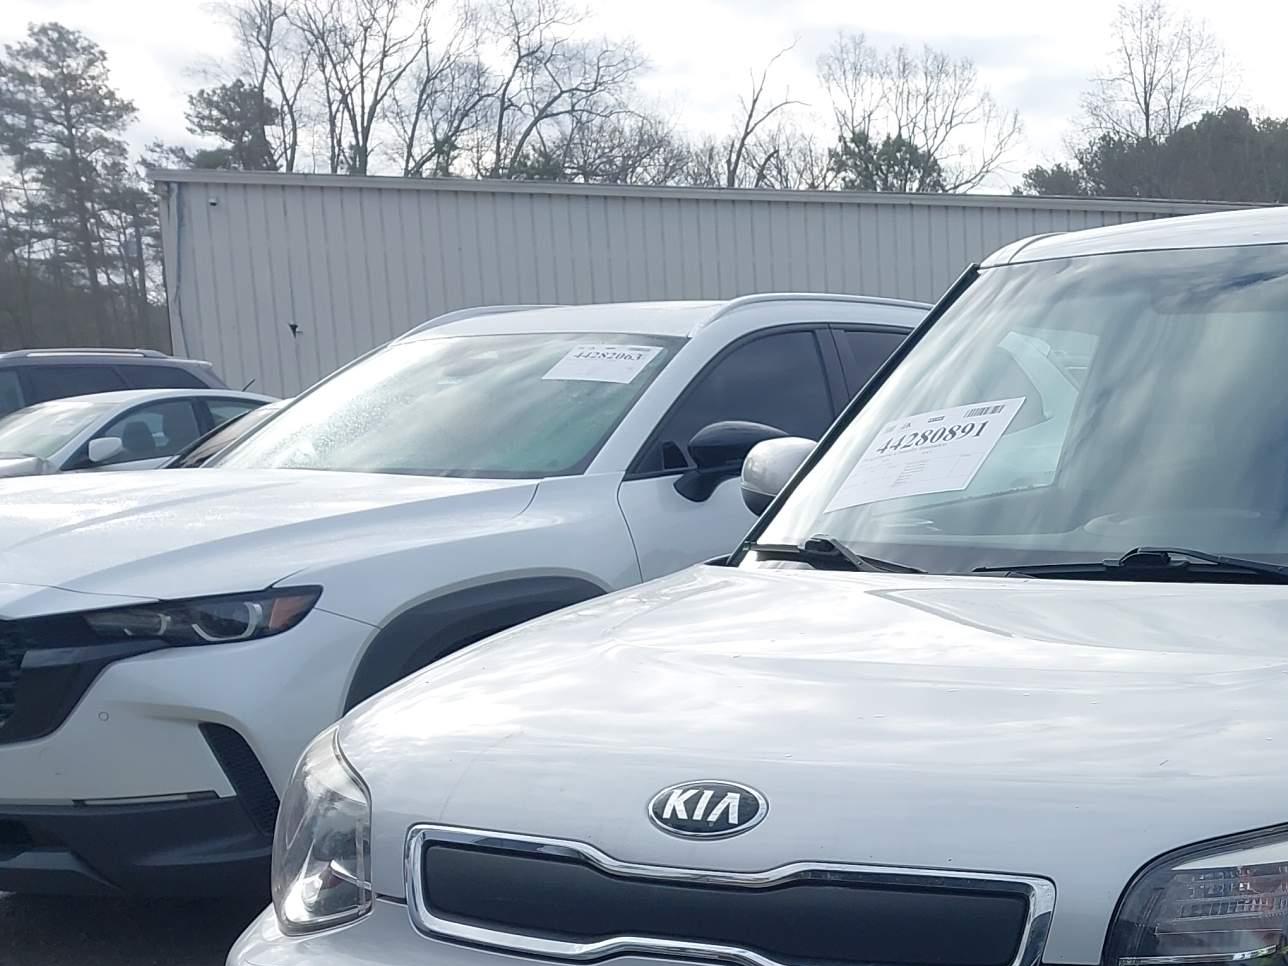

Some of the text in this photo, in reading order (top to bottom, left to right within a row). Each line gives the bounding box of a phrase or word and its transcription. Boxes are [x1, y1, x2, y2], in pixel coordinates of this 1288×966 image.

[574, 351, 643, 361] 44282063
[876, 420, 990, 455] 44280891
[662, 788, 741, 825] KIA
